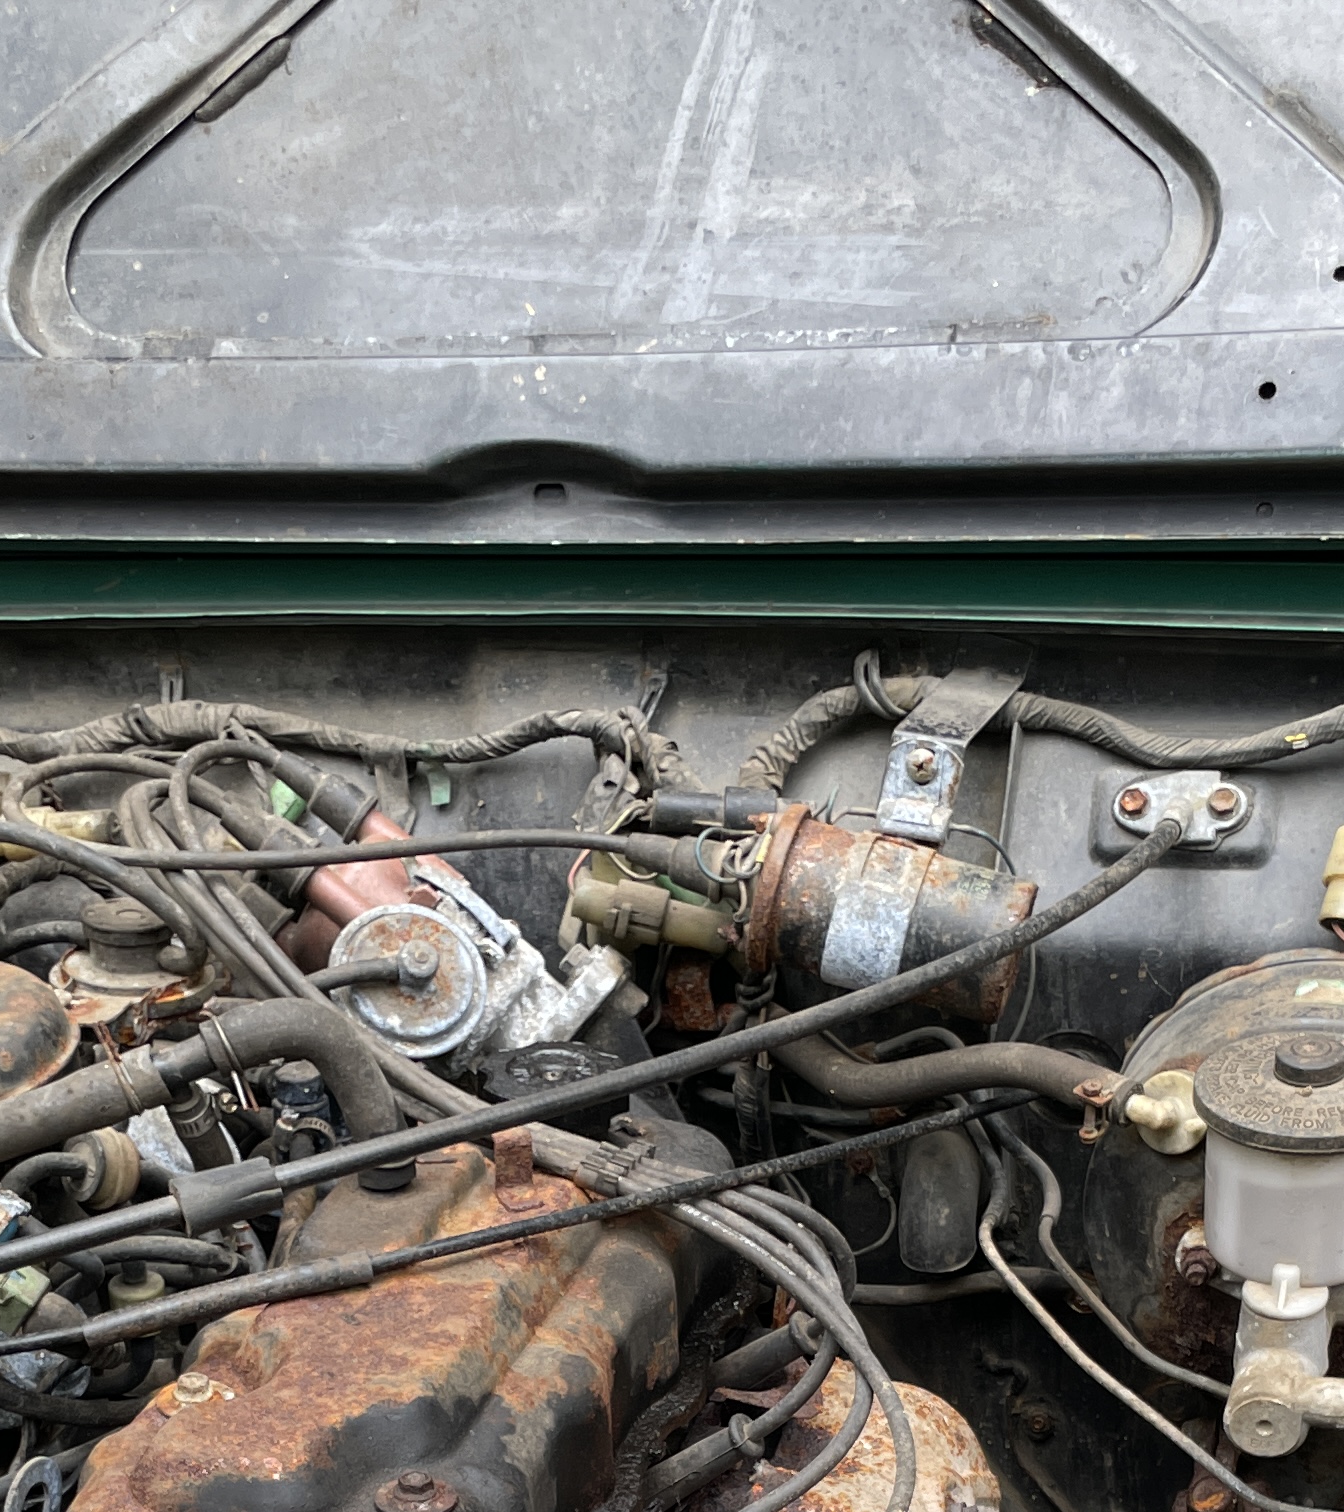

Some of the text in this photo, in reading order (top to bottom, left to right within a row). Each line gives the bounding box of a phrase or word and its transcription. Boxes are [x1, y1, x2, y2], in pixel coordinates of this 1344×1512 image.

[1229, 1103, 1272, 1122] FLUID
[1280, 1117, 1330, 1130] FROM
[1244, 1096, 1305, 1118] BEFORE
